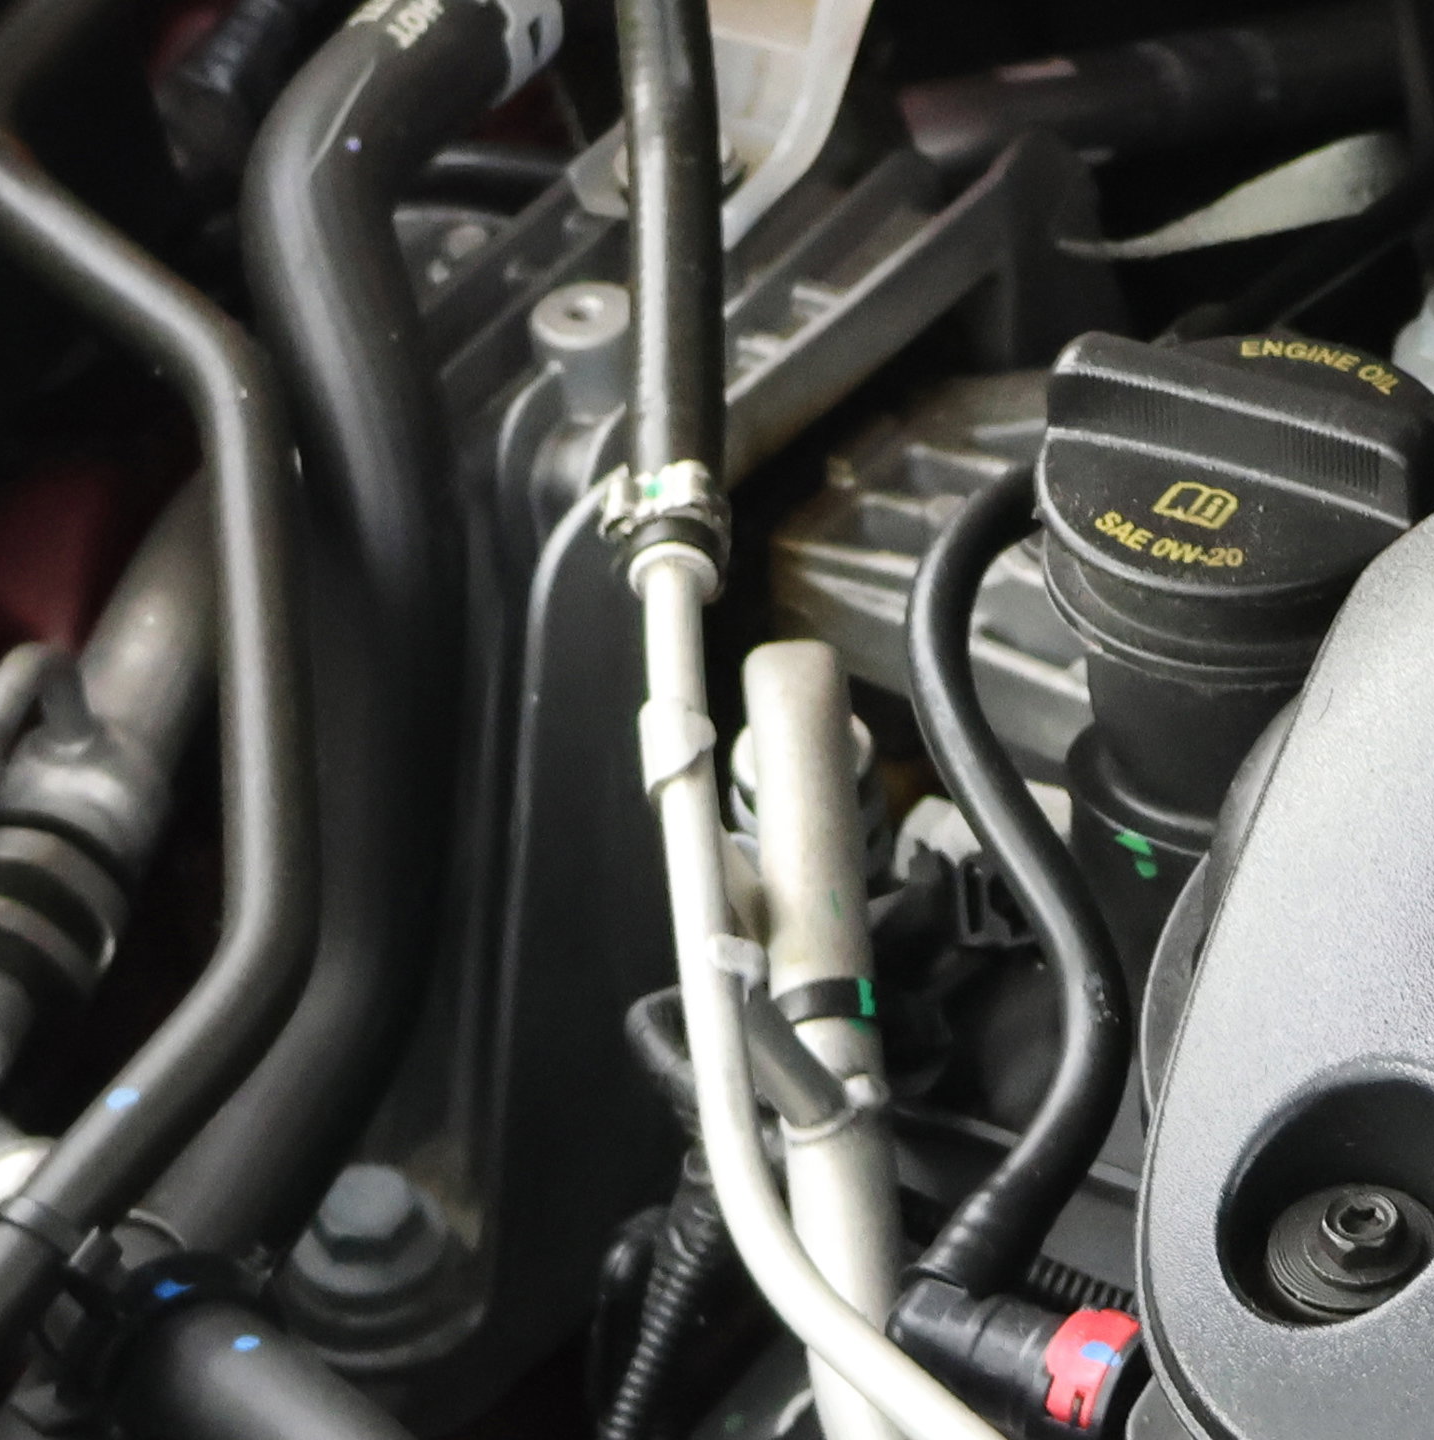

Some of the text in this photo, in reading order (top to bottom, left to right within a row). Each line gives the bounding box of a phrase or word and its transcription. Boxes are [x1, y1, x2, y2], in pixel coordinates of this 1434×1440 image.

[1239, 339, 1400, 397] ENGINE OIL
[1094, 510, 1245, 568] SAE 0W-20
